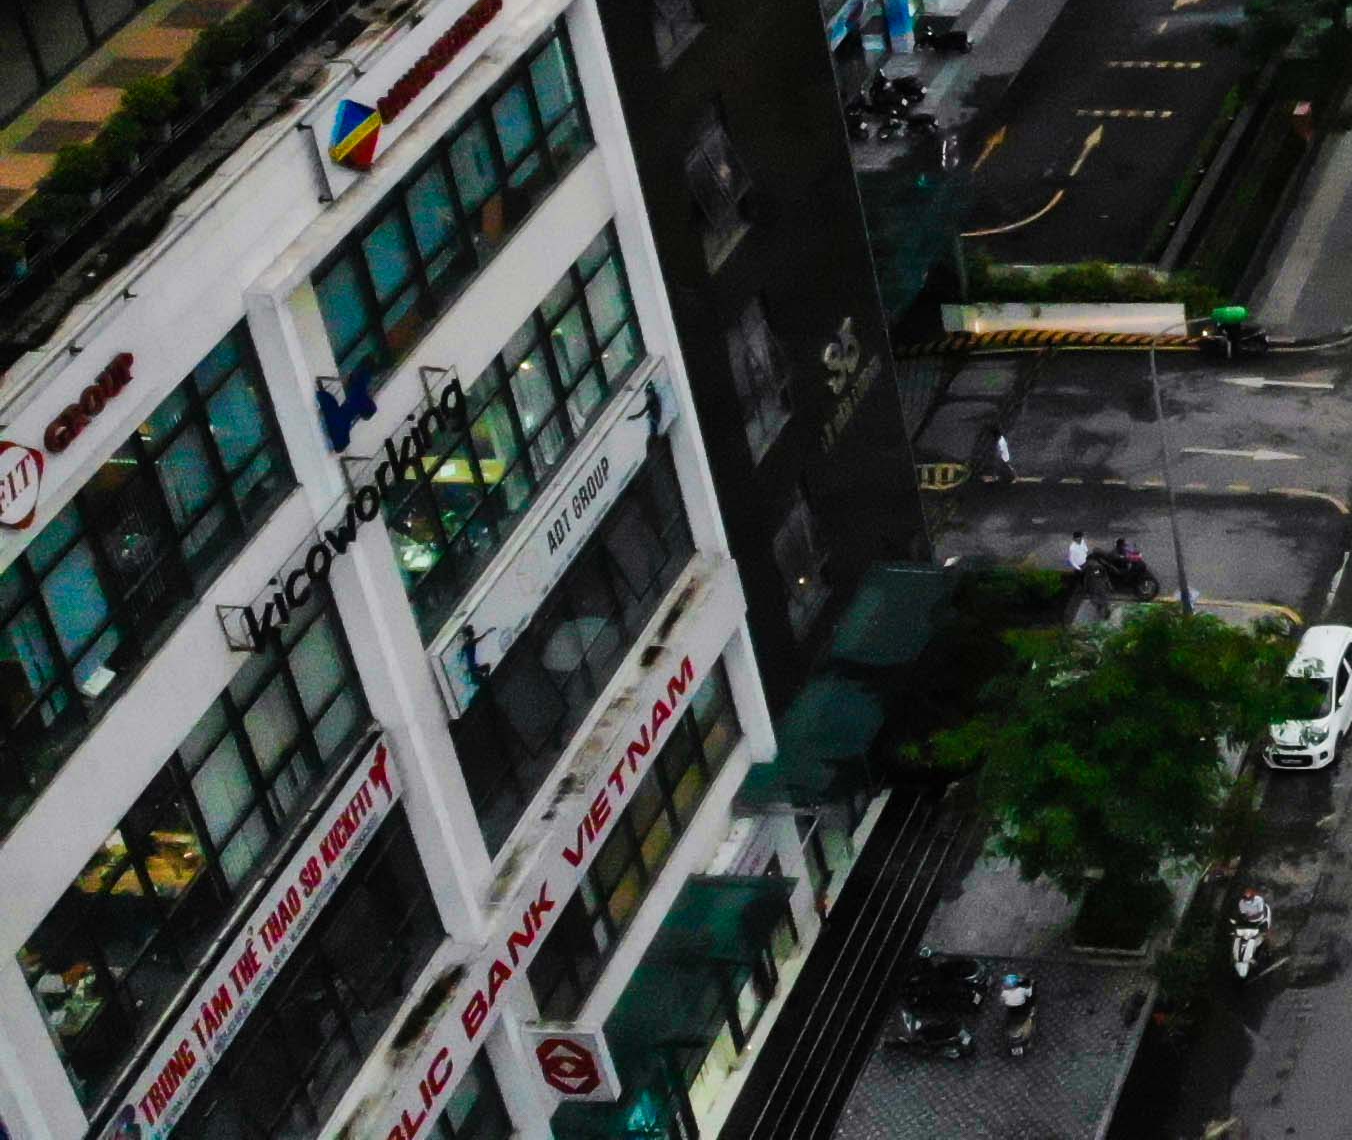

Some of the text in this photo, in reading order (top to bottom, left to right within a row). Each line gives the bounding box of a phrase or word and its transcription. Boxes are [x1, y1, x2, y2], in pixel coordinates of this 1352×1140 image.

[571, 457, 611, 521] GROUP
[462, 880, 556, 1042] BANK
[562, 654, 696, 868] VIETNAM
[138, 1038, 197, 1125] TRUNG
[191, 983, 234, 1050] TÂM
[228, 924, 263, 997] THỂ
[258, 884, 302, 953] THAO
